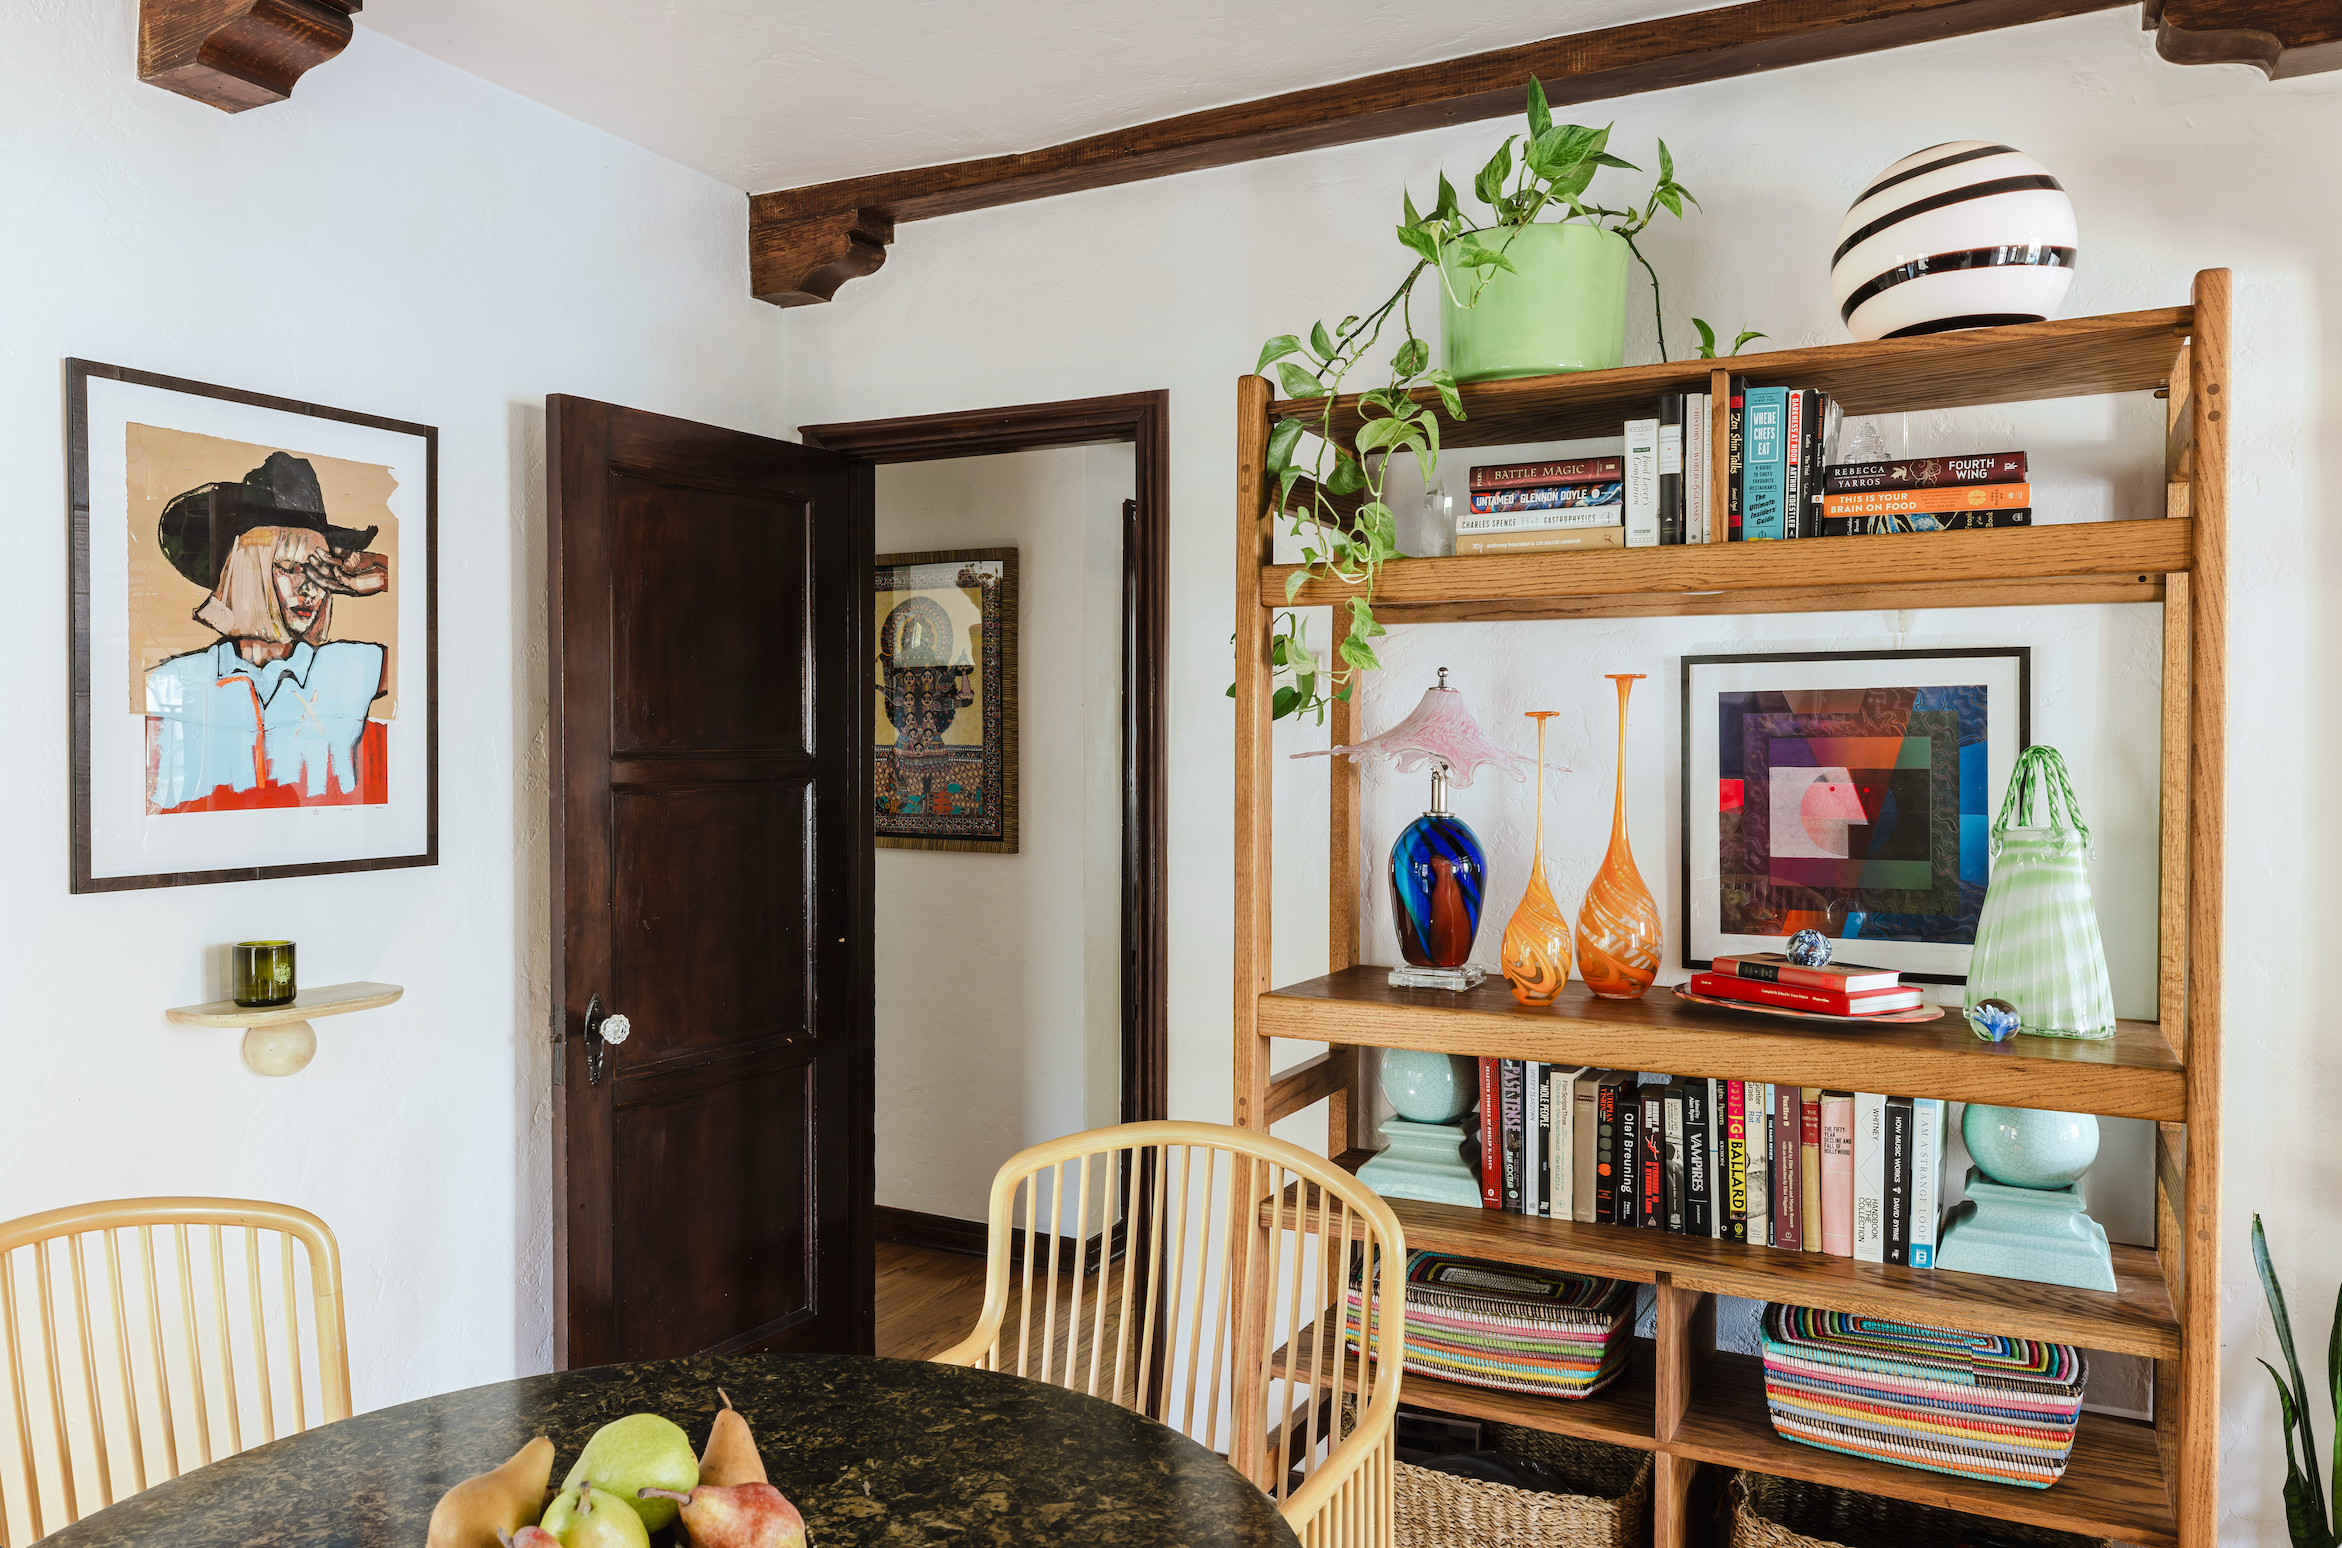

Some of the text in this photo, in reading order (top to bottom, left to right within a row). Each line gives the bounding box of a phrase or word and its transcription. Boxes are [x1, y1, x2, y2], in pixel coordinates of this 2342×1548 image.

[1731, 413, 1740, 430] Zen
[1754, 412, 1776, 425] WHERE
[1754, 428, 1775, 440] CHEFS
[1791, 434, 1798, 442] AT
[1731, 433, 1742, 452] Shin
[1758, 442, 1770, 455] EAT
[1730, 453, 1742, 474] Talks
[1835, 466, 1885, 476] REBECCA
[1949, 458, 1994, 470] FOURTH
[1494, 468, 1537, 480] BATTLE
[1542, 464, 1585, 477] MAGIC
[1956, 469, 1987, 479] WING
[1631, 456, 1642, 506] Companion
[1642, 455, 1652, 506] Food Lover's
[1838, 478, 1880, 488] YARROS
[1476, 489, 1588, 507] UNTAMED GLENNON DOYLE
[1749, 499, 1775, 511] Ultimate
[1750, 506, 1777, 519] Insiders'
[1788, 494, 1796, 528] KOESTLER
[1831, 505, 1862, 513] BRAIN
[1886, 502, 1916, 511] FOOD
[1462, 520, 1490, 529] CHARLES
[1492, 518, 1516, 528] SPENCE
[1544, 514, 1596, 525] GASTROPHYSICS
[1756, 515, 1774, 525] Guide
[1504, 1066, 1521, 1131] PAST TENSE
[1540, 1084, 1549, 1127] MOLE PEOPLE
[1921, 1120, 1929, 1136] AM
[1621, 1113, 1634, 1193] Olaf Breuning
[1690, 1133, 1703, 1191] VAMPIRES
[1731, 1141, 1744, 1209] BALLARD
[1919, 1152, 1928, 1204] STRANGE
[1865, 1198, 1872, 1206] OF
